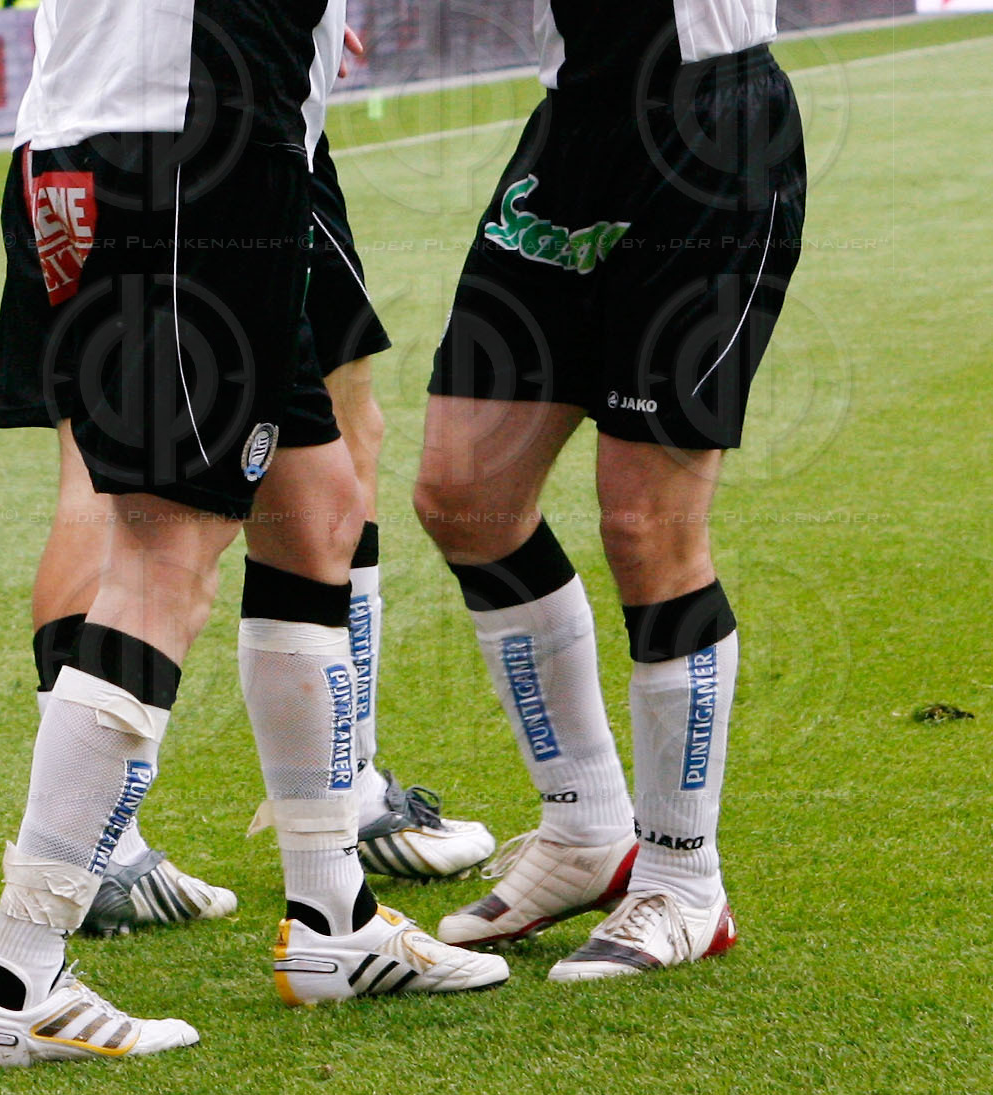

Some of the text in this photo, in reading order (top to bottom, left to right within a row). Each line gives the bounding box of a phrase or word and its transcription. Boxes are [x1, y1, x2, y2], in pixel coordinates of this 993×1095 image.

[620, 396, 658, 413] JAKO
[685, 652, 715, 785] PUNTIGAMER
[645, 830, 704, 850] JAKO
